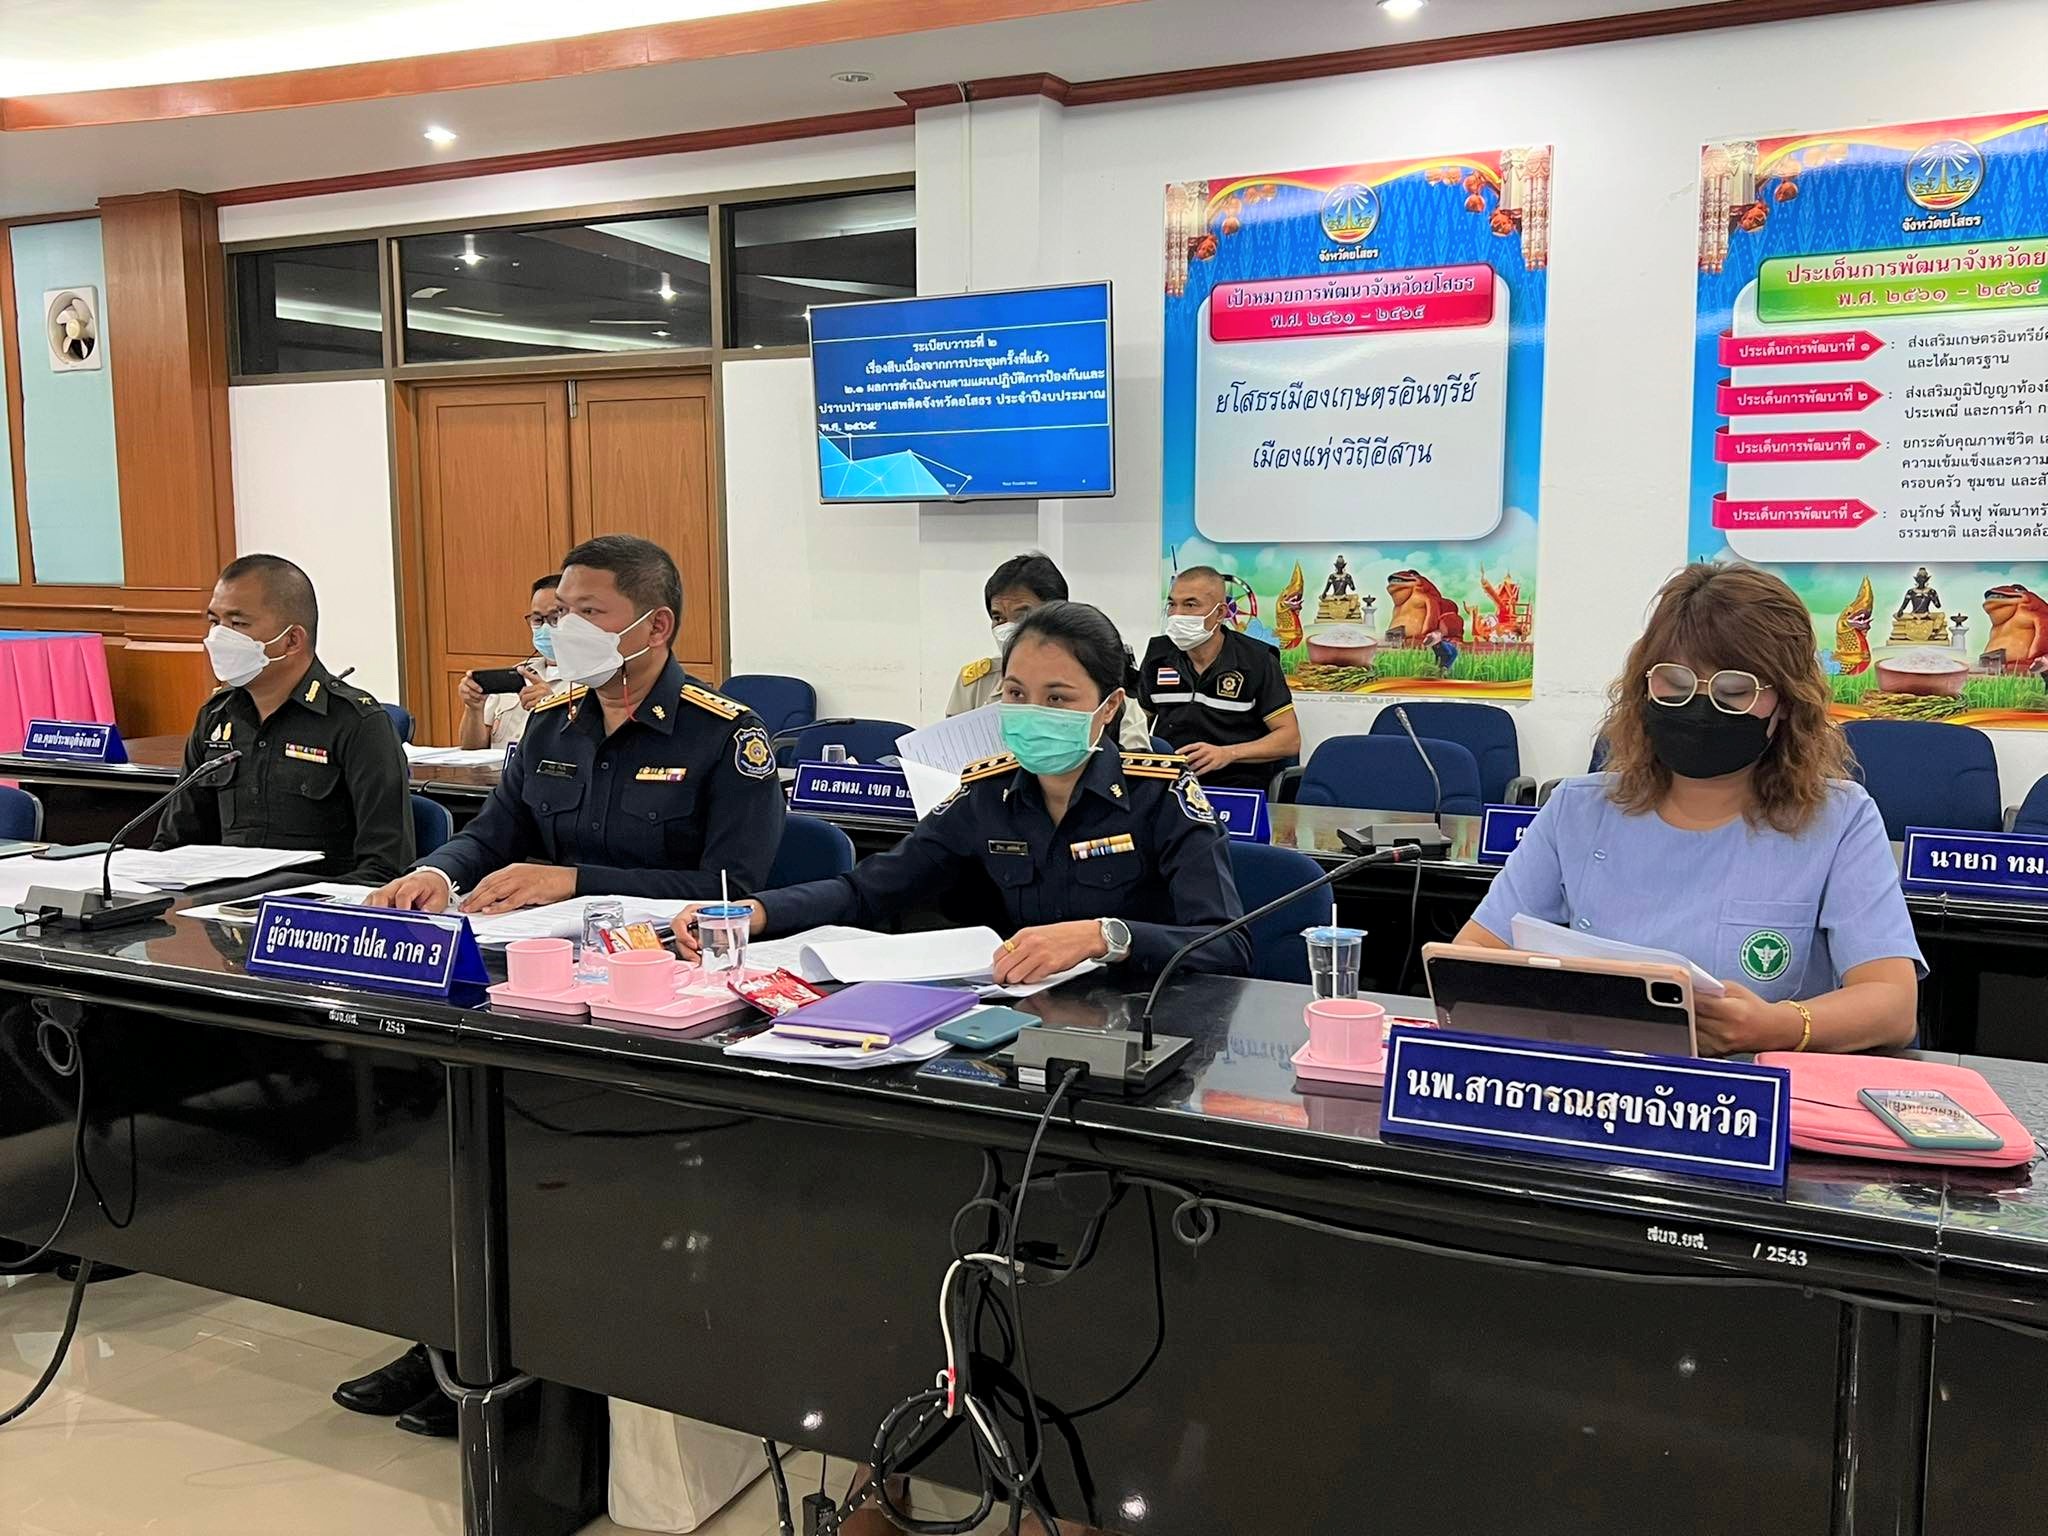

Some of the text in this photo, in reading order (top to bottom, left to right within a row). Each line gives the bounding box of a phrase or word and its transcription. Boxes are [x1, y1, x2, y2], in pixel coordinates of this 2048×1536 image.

[1902, 213, 1982, 232] จังหวัดยโสธร
[1318, 247, 1379, 263] จังหวัดยโสธร
[1787, 243, 2048, 284] ประเด็นการพัฒนาจังหวัดย
[1227, 273, 1475, 308] เป้าหมายการพัฒนาจังหวัดยโสธร
[1837, 291, 1878, 308] พ.ศ.
[1885, 287, 1948, 304] ๒๕๖๑
[1976, 279, 2041, 298] ๒๕๖๕
[1271, 312, 1301, 329] พ.ศ.
[1307, 309, 1356, 327] ๒๕๖๑
[1375, 303, 1426, 322] ๒๕๖๕
[912, 333, 985, 353] ระเบียบวาระที่
[1738, 334, 1871, 359] ประเด็นการพัฒนาที่ ๑
[865, 350, 1050, 375] เรื่องสืบเนื่องจากการประชุมครั้งที่แล้ว
[1908, 352, 2010, 370] และได้มาตรฐาน
[818, 388, 1106, 415] ปราบปรามยาเสพติดจังหวัดยโสธร ประจำปีงบประมาณ
[1215, 372, 1481, 415] ยโสธรเมืองเกษตรอินทรีย์
[1737, 384, 1869, 407] ประเด็นการพัฒนาที่ ๒
[1904, 403, 1959, 419] ประเพณี
[1964, 400, 2032, 417] และการค้า
[1735, 434, 1852, 456] ประเด็นการพัฒนาที่
[1903, 431, 2034, 452] ยกระดับคุณภาพชีวิต
[1252, 436, 1433, 471] เมืองแห่งวิถีอีสาน
[1901, 474, 1962, 489] ครอบครัว
[1967, 477, 2006, 491] ชุมชน
[1732, 502, 1848, 522] ประเด็นการพัฒนาที่
[1899, 503, 1945, 522] อนุรักษ์
[1950, 500, 1983, 522] ฟื้นฟู
[1898, 524, 1956, 539] ธรรมชาติ
[810, 778, 863, 796] ผอ.สพม.
[867, 783, 891, 797] เขต
[1930, 850, 1997, 872] นายก
[265, 915, 442, 967] ผู้อำนวยการ ปปส. ภาค 3
[385, 1020, 406, 1035] 2543
[1407, 1067, 1758, 1138] นพ.สาธารณสุขจังหวัด
[1766, 1246, 1808, 1267] 2543
